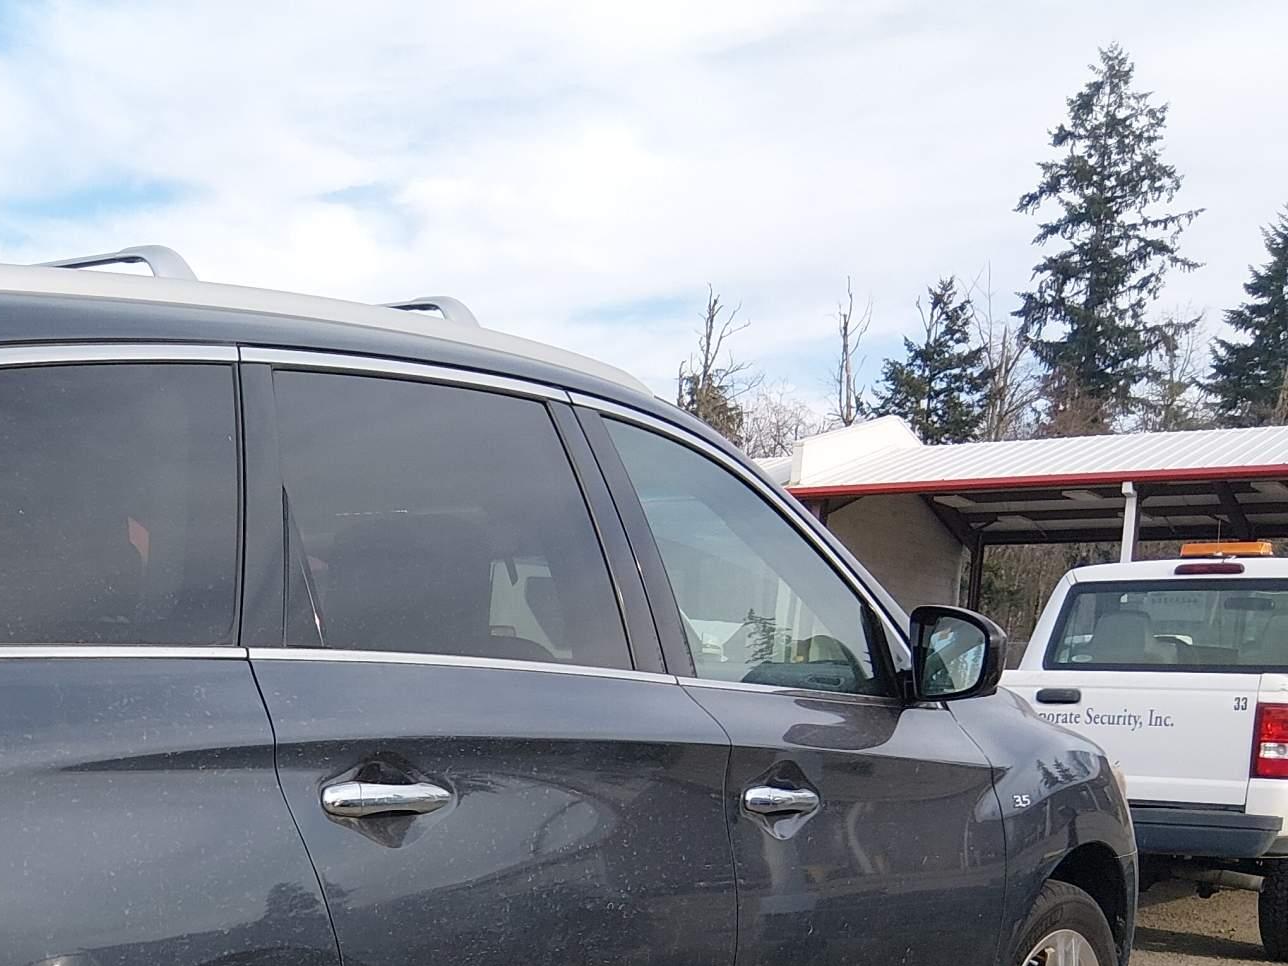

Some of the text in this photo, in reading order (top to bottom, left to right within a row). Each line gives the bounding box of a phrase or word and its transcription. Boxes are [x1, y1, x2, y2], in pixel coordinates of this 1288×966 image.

[1233, 697, 1248, 711] 33
[1084, 707, 1143, 731] Security,
[1148, 709, 1175, 728] Inc.
